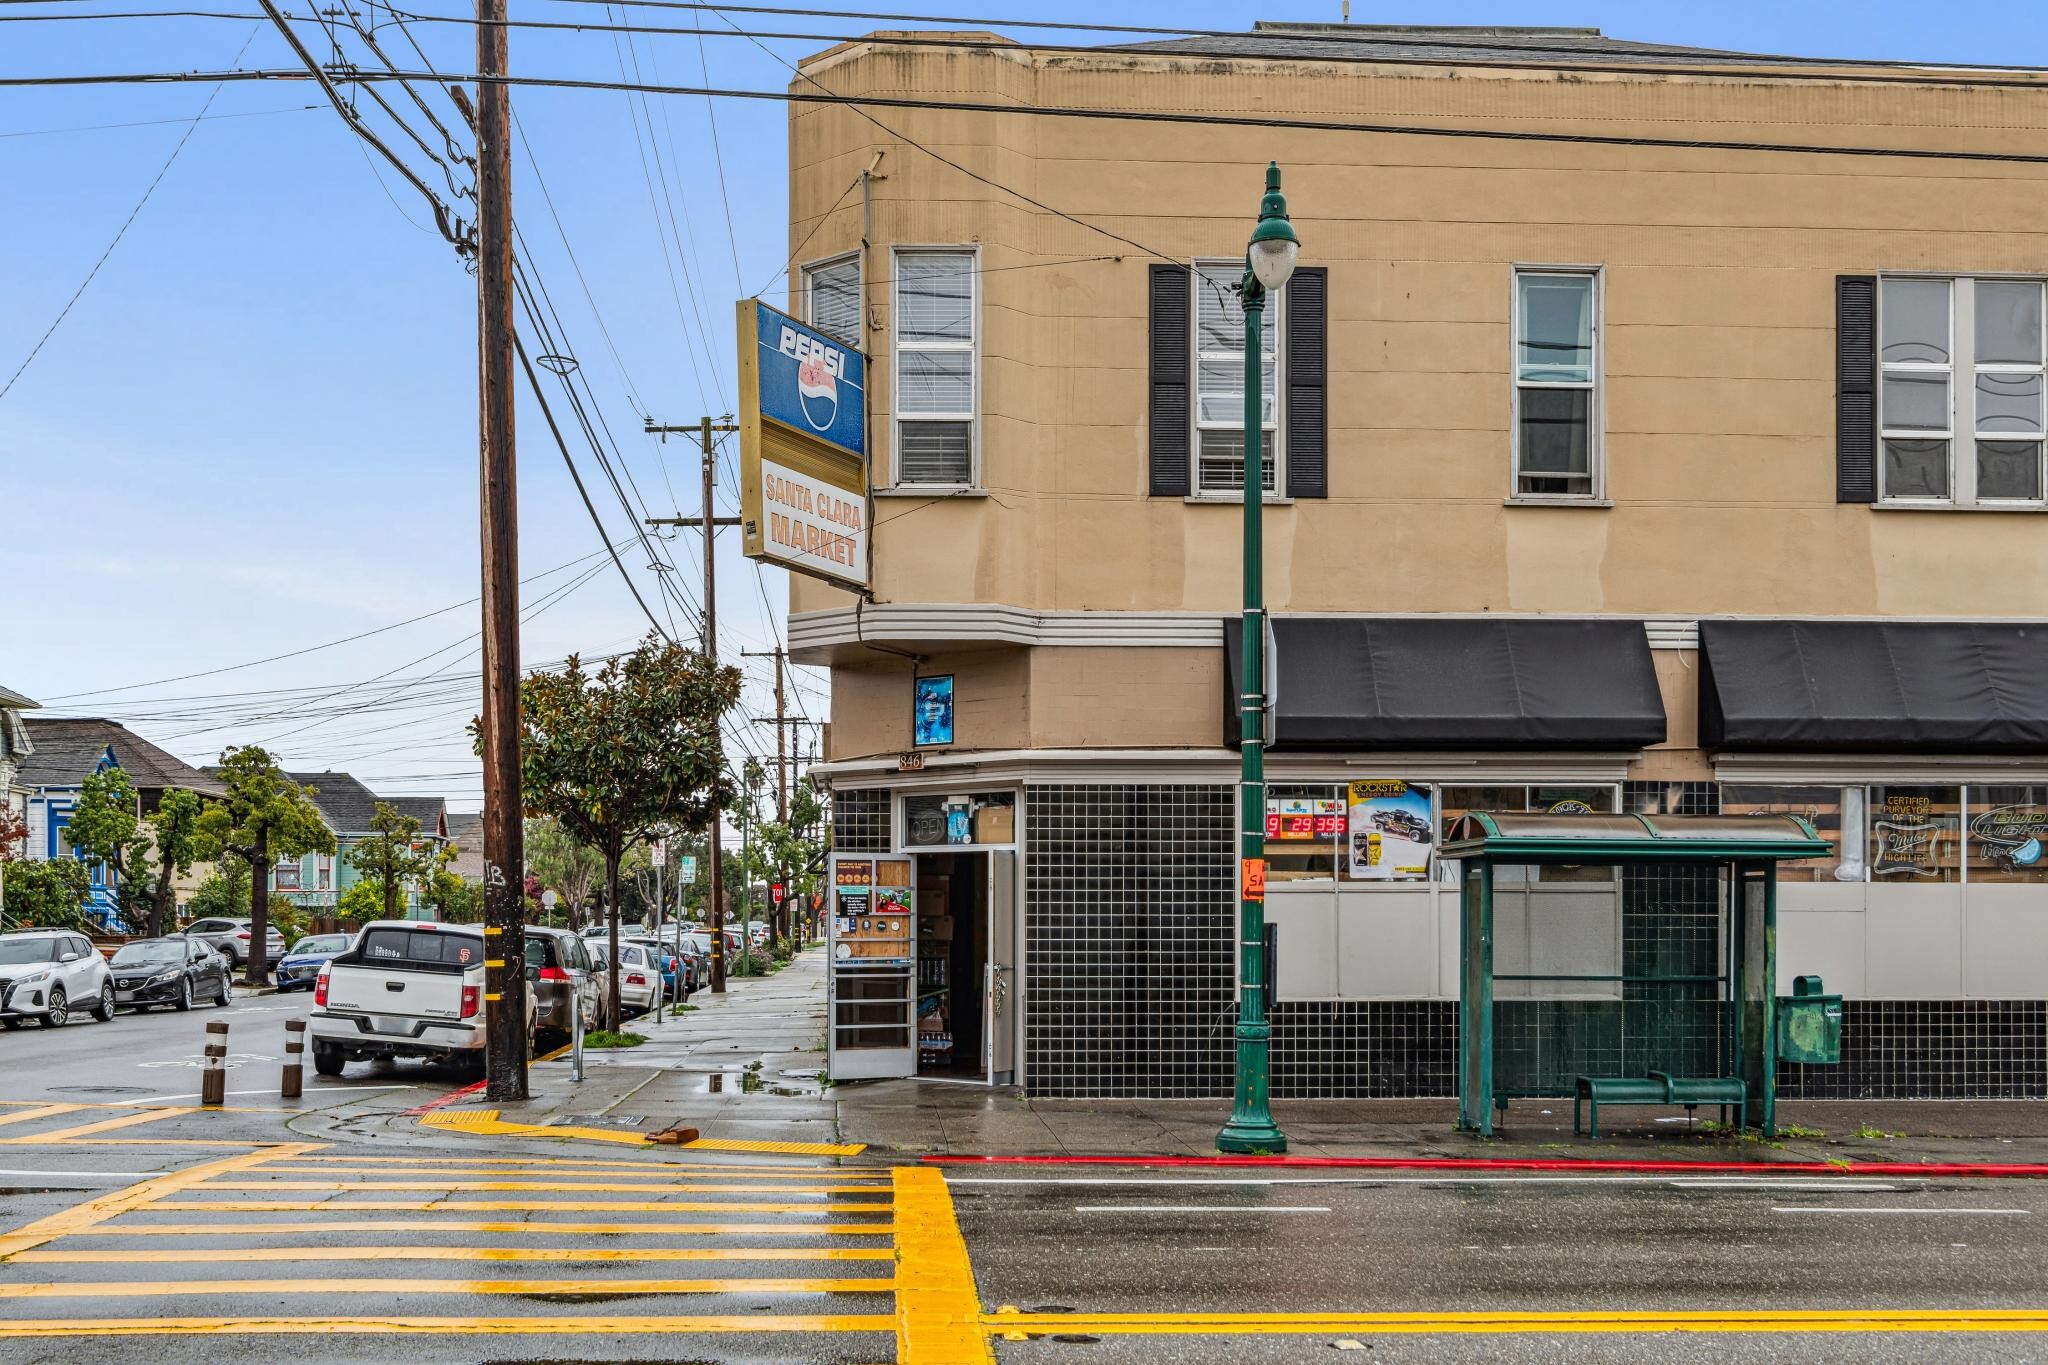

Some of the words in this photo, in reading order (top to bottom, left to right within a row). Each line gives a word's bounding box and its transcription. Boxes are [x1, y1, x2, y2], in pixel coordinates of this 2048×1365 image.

[780, 324, 846, 380] PEPSI
[765, 473, 814, 515] SANTA
[816, 492, 862, 531] CLARA
[770, 511, 857, 568] MARKET
[899, 754, 921, 769] 846
[1353, 783, 1408, 793] ROCKSTAR
[1887, 796, 1930, 806] CERTIFIED
[1883, 805, 1930, 815] PURVEYOR
[1292, 817, 1312, 831] 29
[1892, 814, 1904, 823] OF
[1908, 814, 1925, 824] THE
[1994, 811, 2047, 824] BUD
[912, 818, 945, 836] OPEN
[1981, 824, 2048, 837] LIGHT
[1888, 833, 1927, 849] Miller
